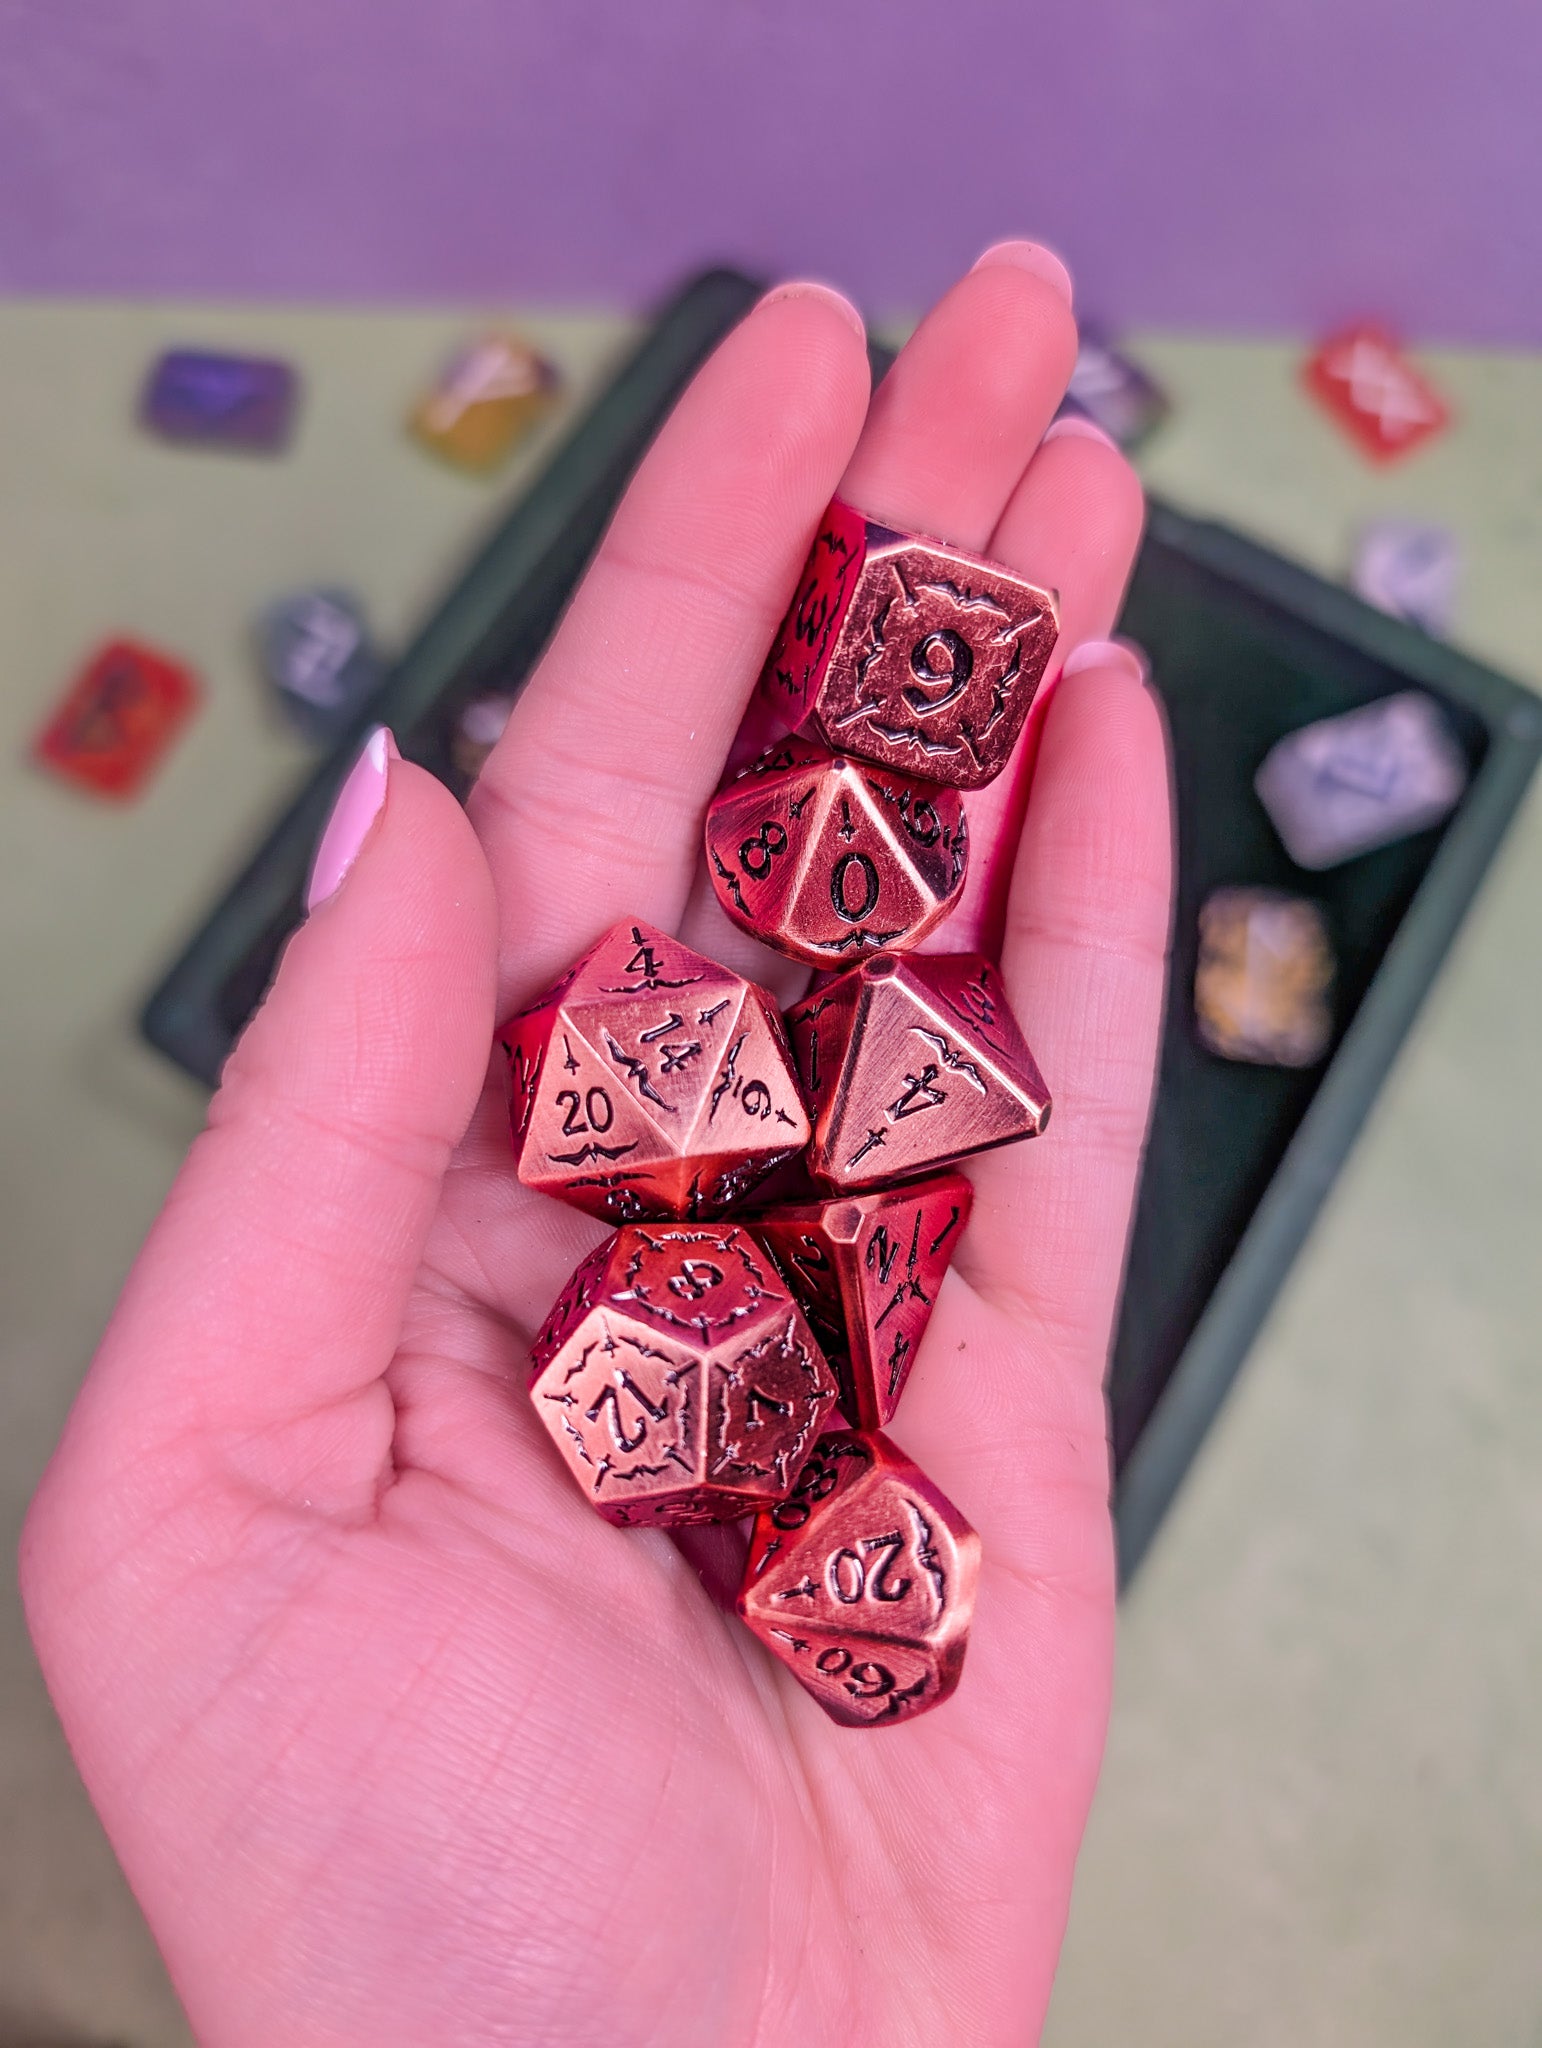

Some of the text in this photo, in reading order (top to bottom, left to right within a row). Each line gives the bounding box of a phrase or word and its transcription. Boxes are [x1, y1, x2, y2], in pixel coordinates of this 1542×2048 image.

[738, 820, 788, 881] 8
[830, 852, 879, 923] 0
[625, 947, 663, 977] 4
[641, 1013, 701, 1073] 14
[556, 1086, 614, 1137] 20
[883, 1064, 948, 1124] 4
[668, 1259, 724, 1301] 8
[585, 1367, 666, 1451] 12
[824, 1530, 912, 1605] 20
